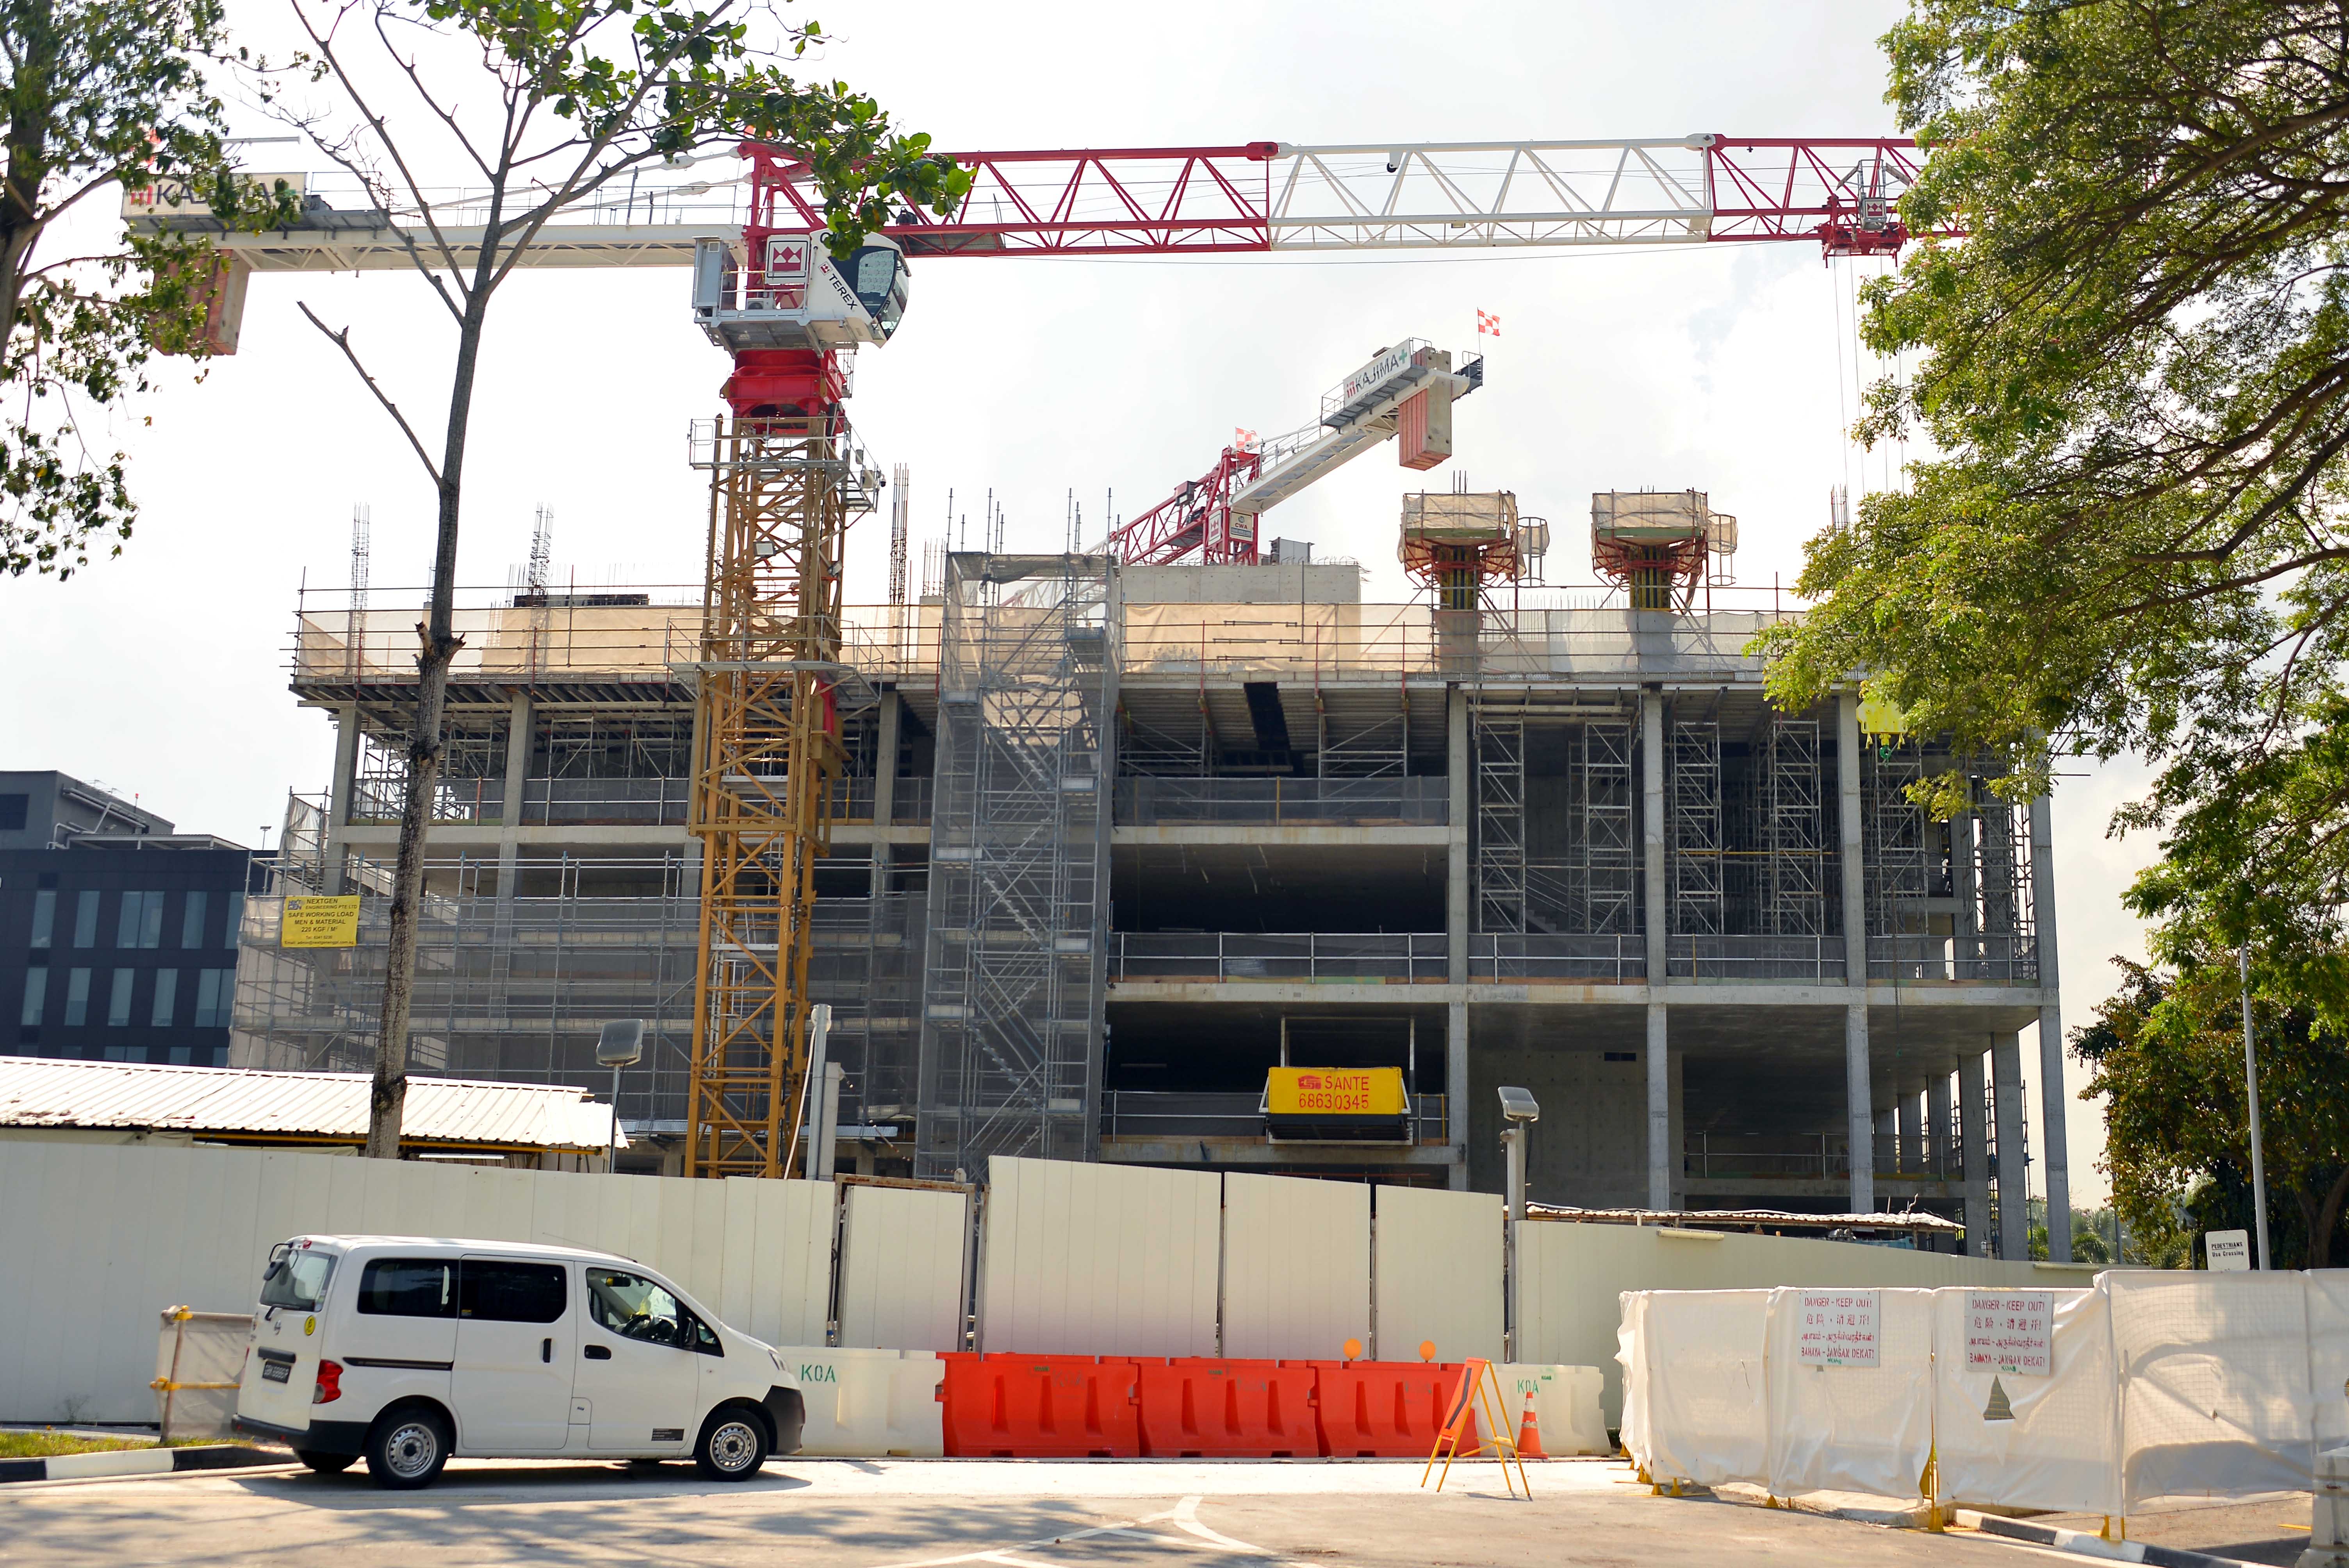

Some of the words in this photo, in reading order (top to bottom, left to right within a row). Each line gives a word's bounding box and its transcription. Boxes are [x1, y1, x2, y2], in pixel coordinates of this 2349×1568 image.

[829, 273, 857, 310] TEREX
[1355, 354, 1399, 392] KAJIMA
[1325, 1076, 1369, 1090] SANTE
[1299, 1093, 1369, 1110] 68630345
[1805, 1297, 1829, 1307] DANGER
[1836, 1297, 1852, 1307] KEEP
[1856, 1298, 1871, 1308] OUT!
[1972, 1299, 1999, 1310] DANGER
[2007, 1300, 2024, 1311] KEEP
[2028, 1301, 2044, 1311] OUT!
[1802, 1347, 1820, 1357] BAHAYA
[1827, 1347, 1849, 1358] JANGAN
[1852, 1349, 1874, 1359] DEKAT!
[1969, 1352, 1991, 1363] BAHAYA
[1998, 1354, 2021, 1365] JANGAN
[2024, 1356, 2045, 1367] DEKAT!
[801, 1364, 836, 1382] KOA
[1518, 1379, 1539, 1393] KOA
